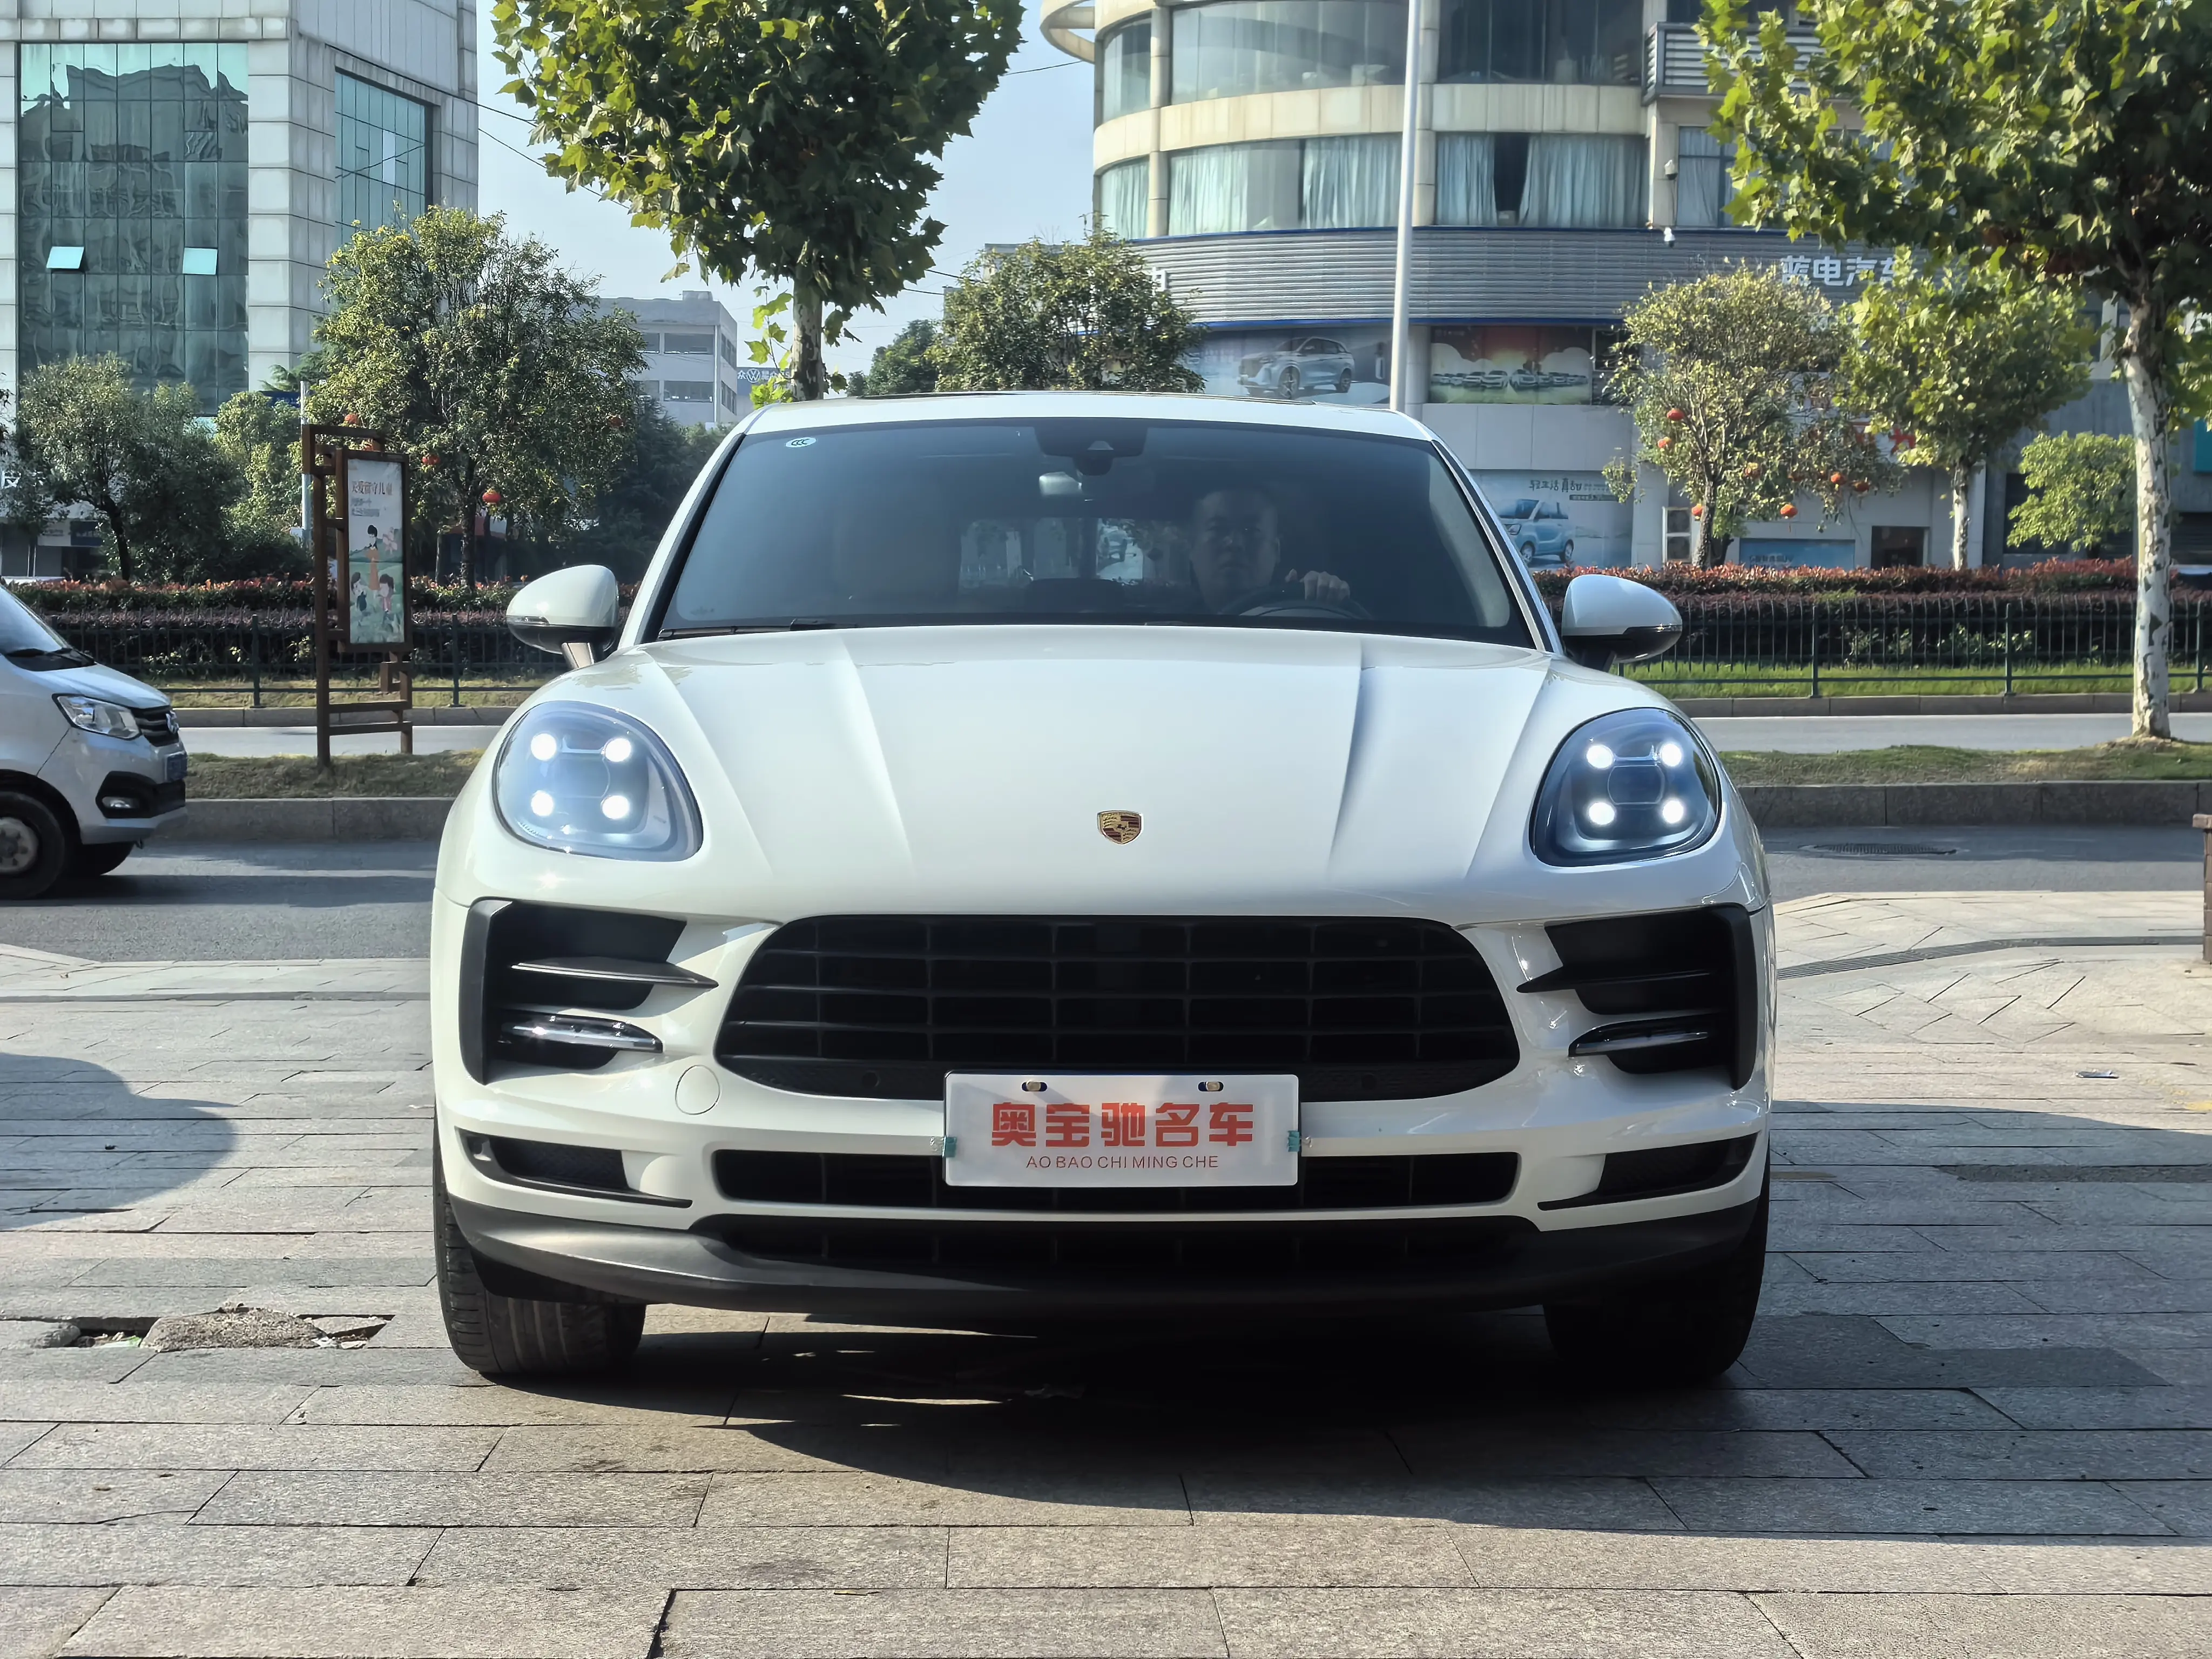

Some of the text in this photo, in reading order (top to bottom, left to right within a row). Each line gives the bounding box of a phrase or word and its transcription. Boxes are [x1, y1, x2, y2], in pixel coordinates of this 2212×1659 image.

[992, 1102, 1253, 1147] 奥宝驰名车
[1026, 1156, 1218, 1168] AO BAO CHI MING CHE
